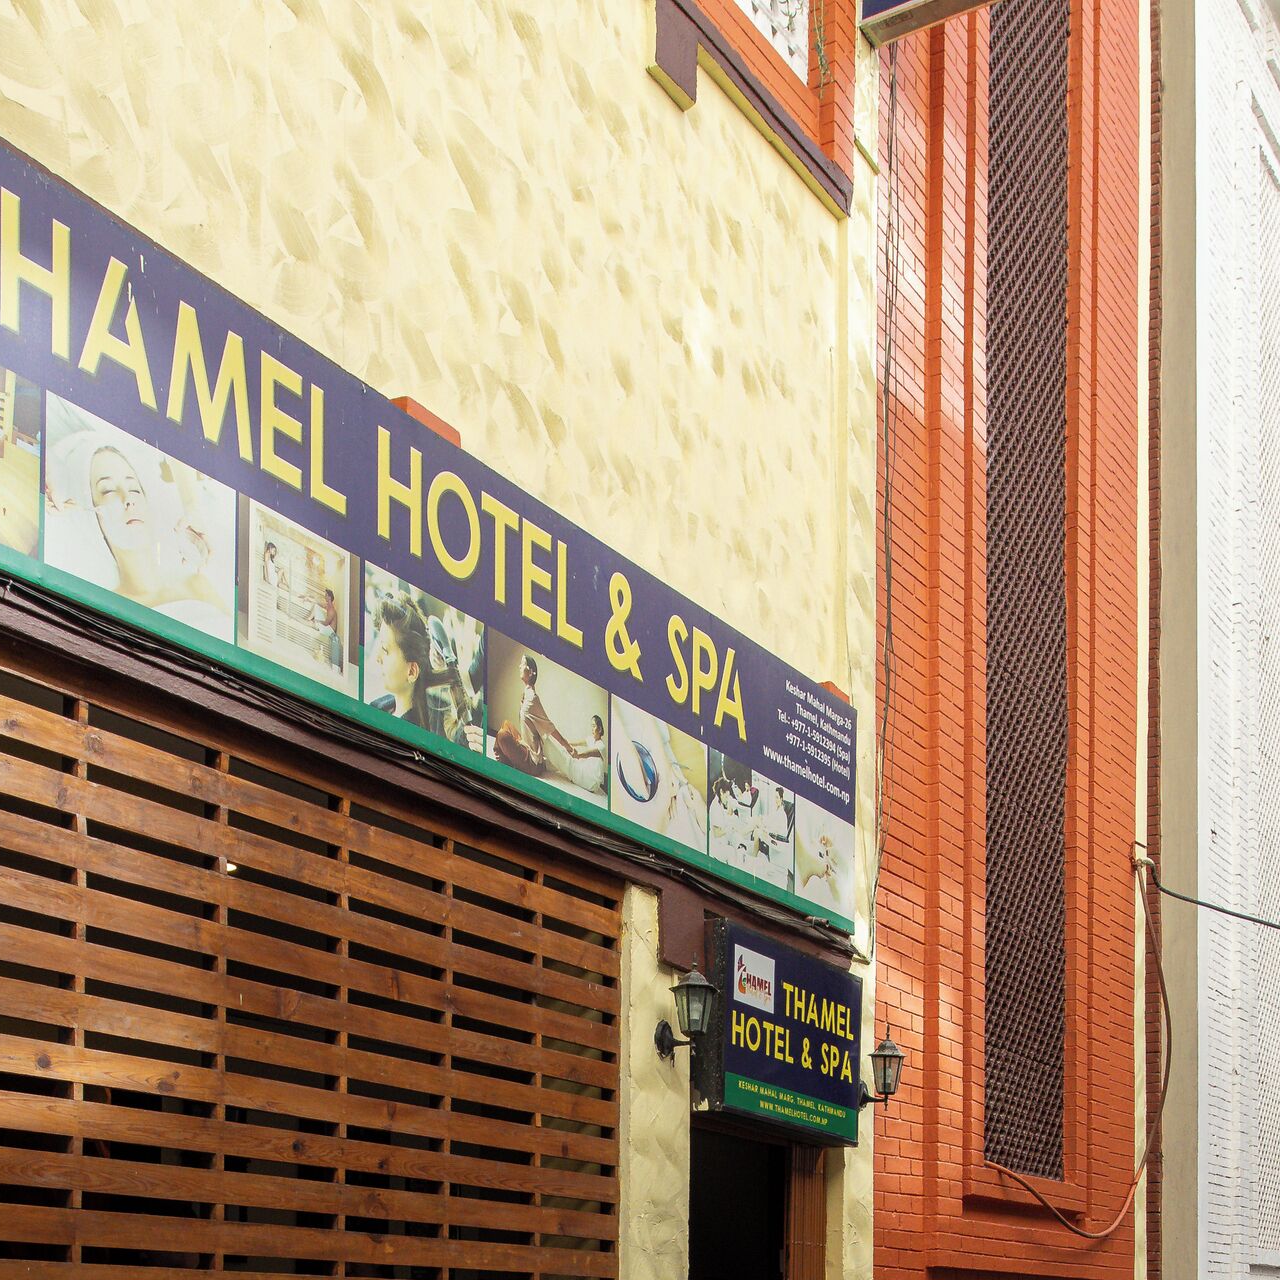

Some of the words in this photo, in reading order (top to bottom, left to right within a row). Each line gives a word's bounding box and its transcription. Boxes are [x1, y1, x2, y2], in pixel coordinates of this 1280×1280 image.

[377, 424, 584, 652] HOTEL
[604, 572, 644, 683] &
[665, 614, 748, 744] SPA
[785, 680, 806, 700] Keshar
[807, 692, 825, 713] Mahal
[826, 705, 852, 730] Marga-26
[796, 703, 819, 728] Thamel,
[820, 718, 851, 746] Kathmandu
[785, 733, 831, 767] +977-1-5912395
[831, 758, 851, 781] (Hotel)
[791, 719, 836, 754] +977-1-5912394
[836, 745, 851, 765] (Spa)
[763, 745, 850, 805] www.thamelhotel.com.np
[782, 981, 854, 1041] THAMEL
[732, 1010, 794, 1064] HOTEL
[801, 1037, 812, 1070] &
[821, 1042, 852, 1084] SPA
